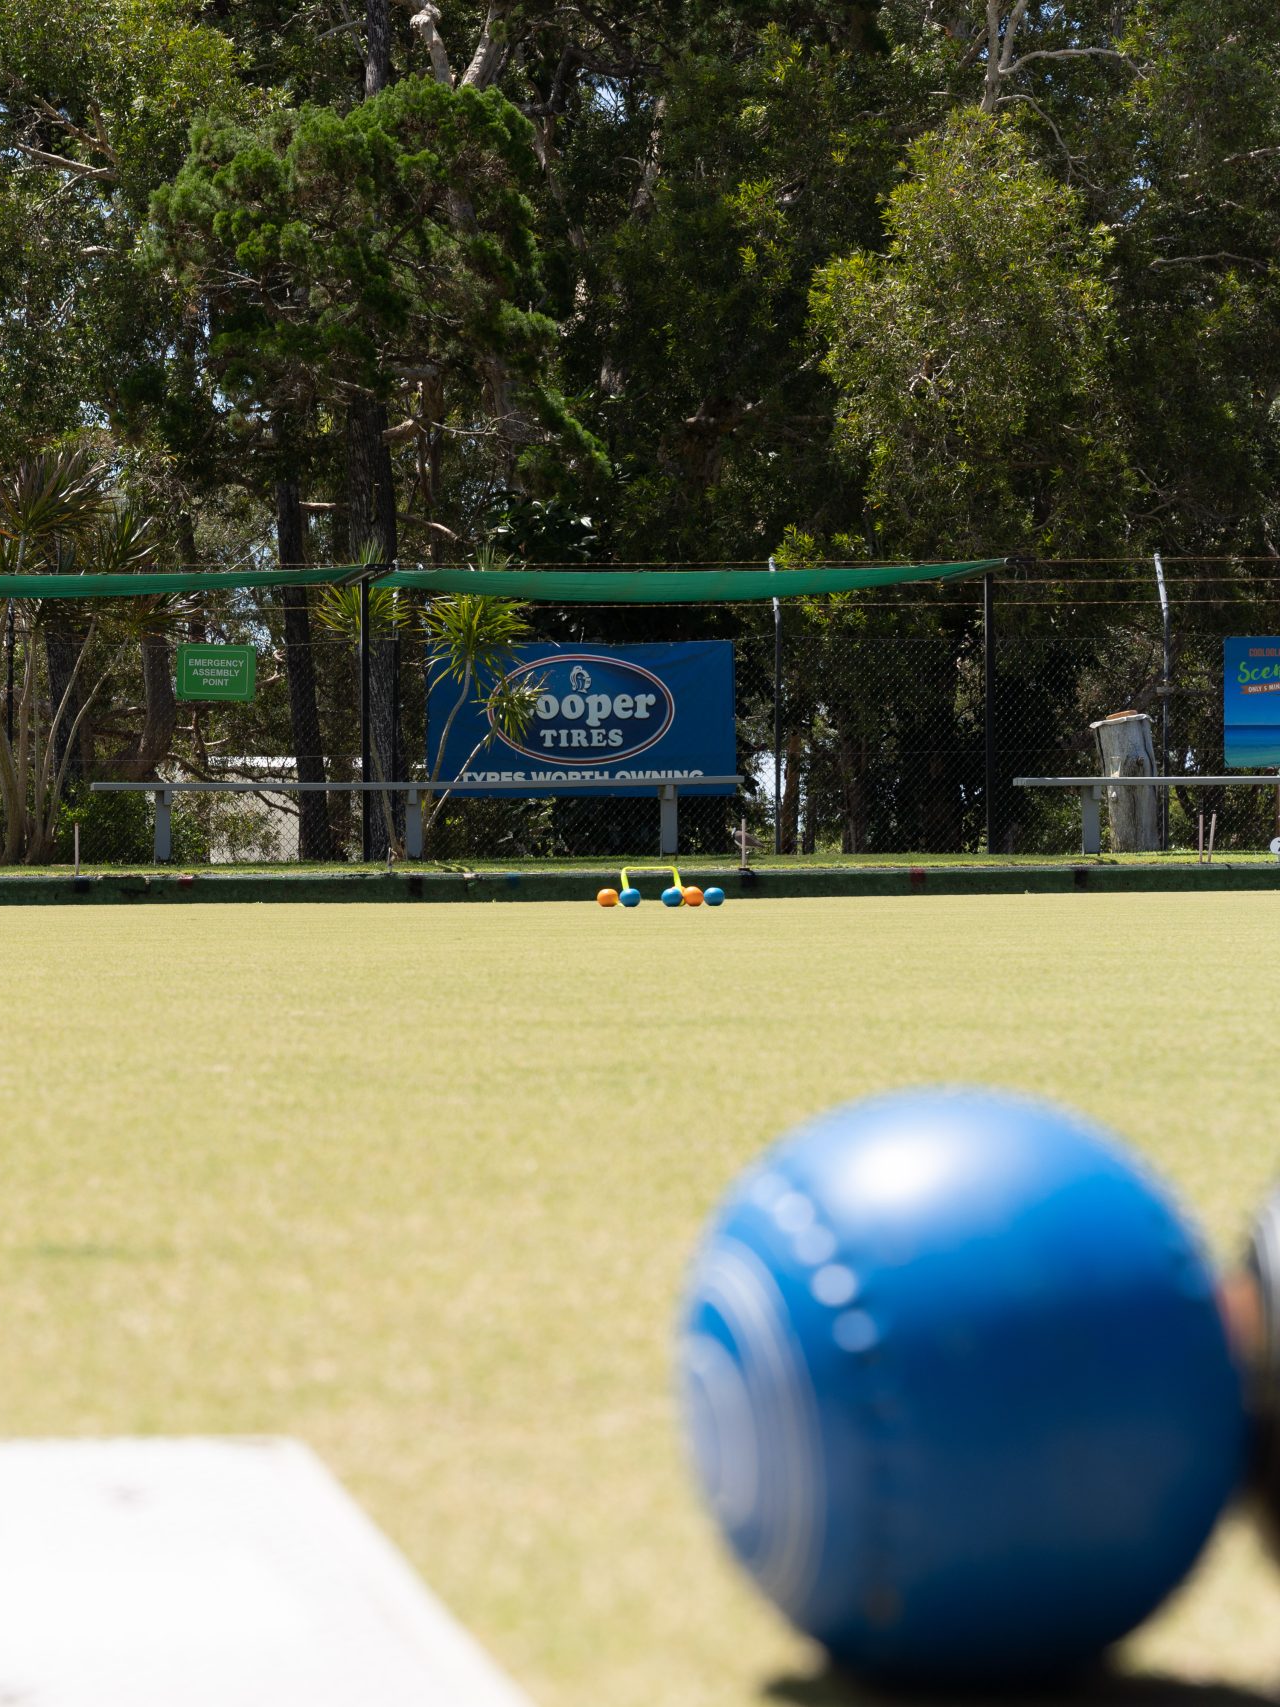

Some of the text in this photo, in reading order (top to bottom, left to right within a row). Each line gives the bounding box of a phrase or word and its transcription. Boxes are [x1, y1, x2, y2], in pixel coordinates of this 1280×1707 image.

[188, 658, 244, 668] EMERGENCY
[192, 668, 239, 677] ASSEMBLY
[202, 678, 229, 687] POINT
[528, 694, 656, 727] ooper
[540, 729, 624, 747] TIRES
